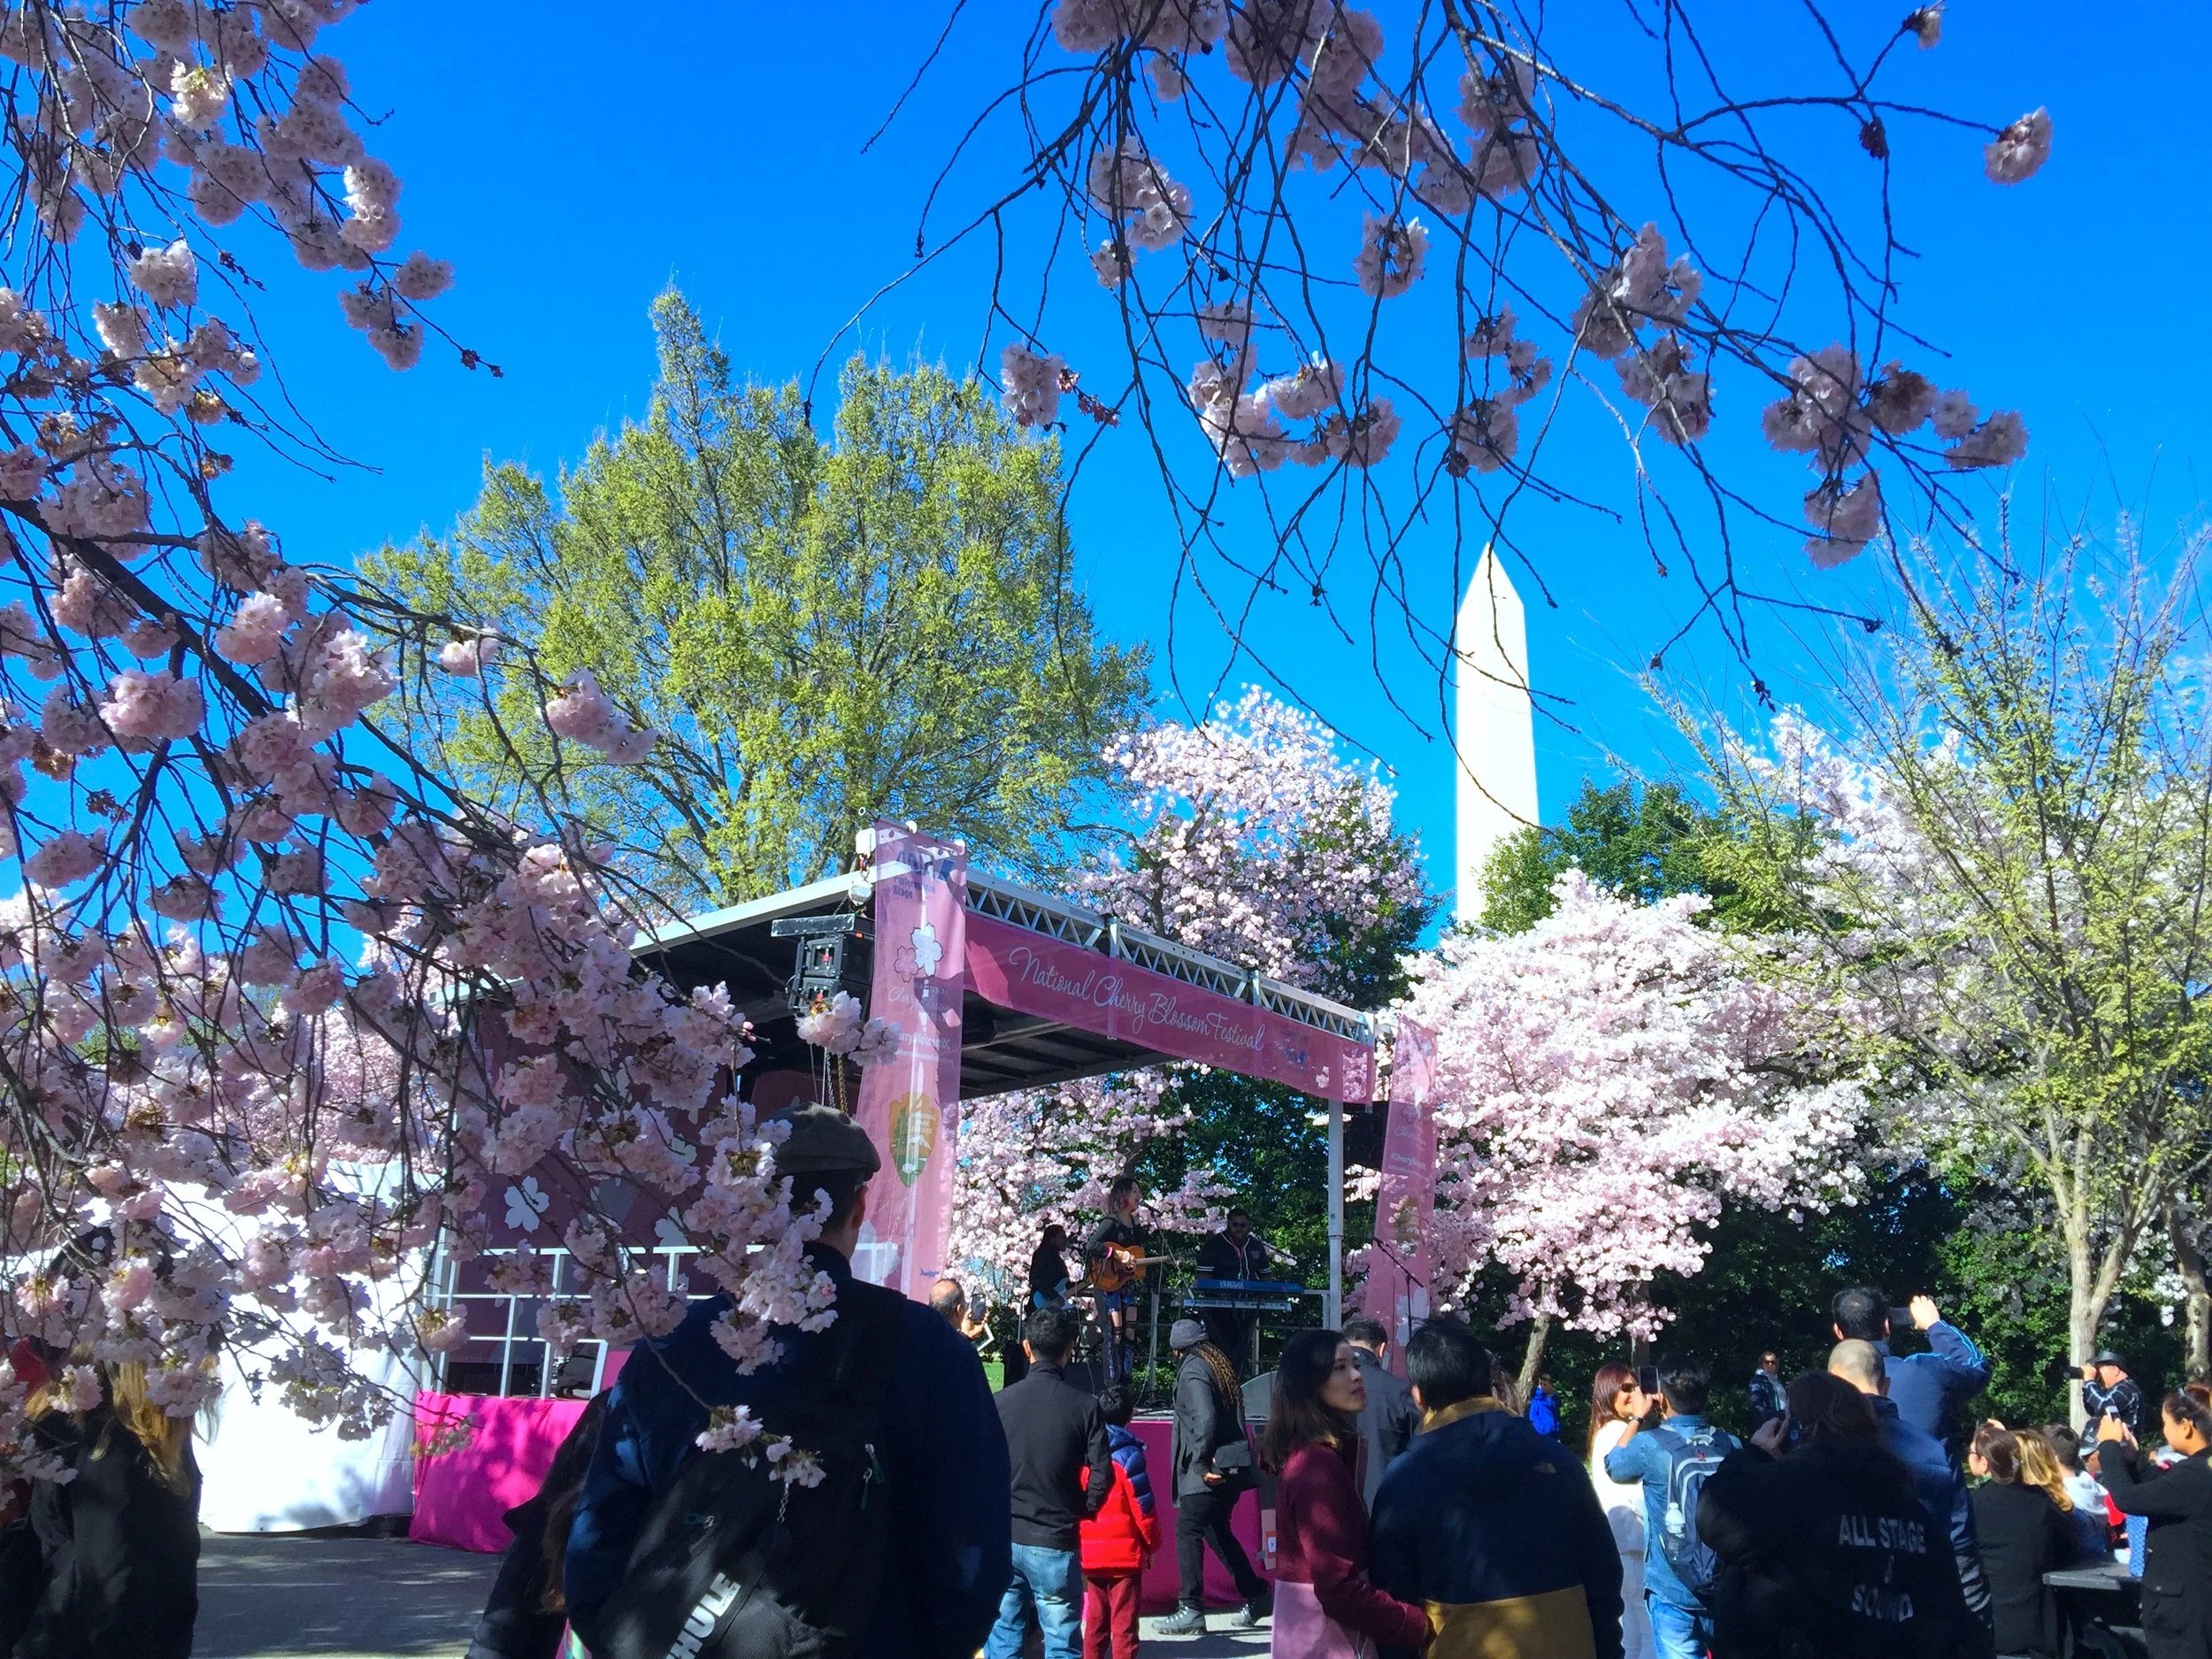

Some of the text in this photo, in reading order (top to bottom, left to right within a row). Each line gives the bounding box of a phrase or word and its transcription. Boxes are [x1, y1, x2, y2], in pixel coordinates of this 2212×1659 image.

[893, 885, 913, 899] Stage
[1009, 947, 1265, 1052] National Cherry Blossom Festival
[1839, 1514, 1926, 1554] ALL STAGE
[665, 1572, 741, 1659] HULE
